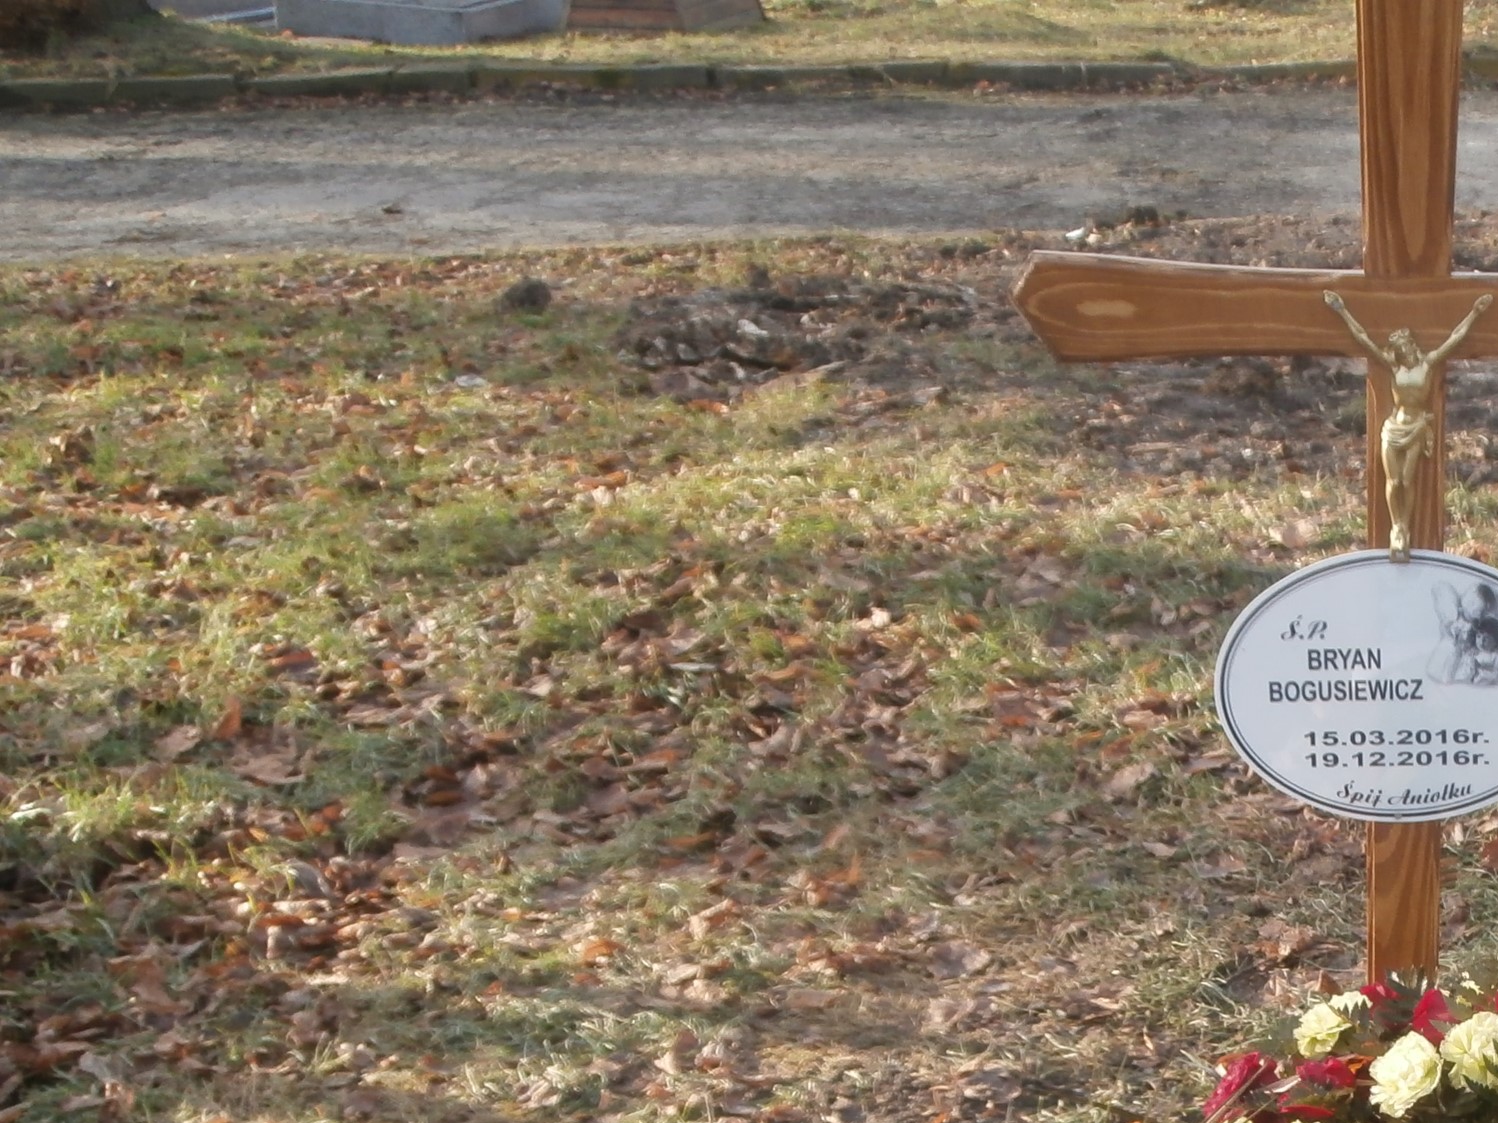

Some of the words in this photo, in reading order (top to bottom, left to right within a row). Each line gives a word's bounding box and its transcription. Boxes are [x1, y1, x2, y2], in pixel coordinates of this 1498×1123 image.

[1280, 614, 1328, 642] Ś.P.
[1307, 648, 1382, 671] BRYAN
[1268, 679, 1424, 702] BOGUSIEWICZ
[1303, 729, 1490, 747] 15.03.2016r.
[1304, 750, 1490, 768] 19.12.2016r.
[1336, 780, 1383, 808] Śpij
